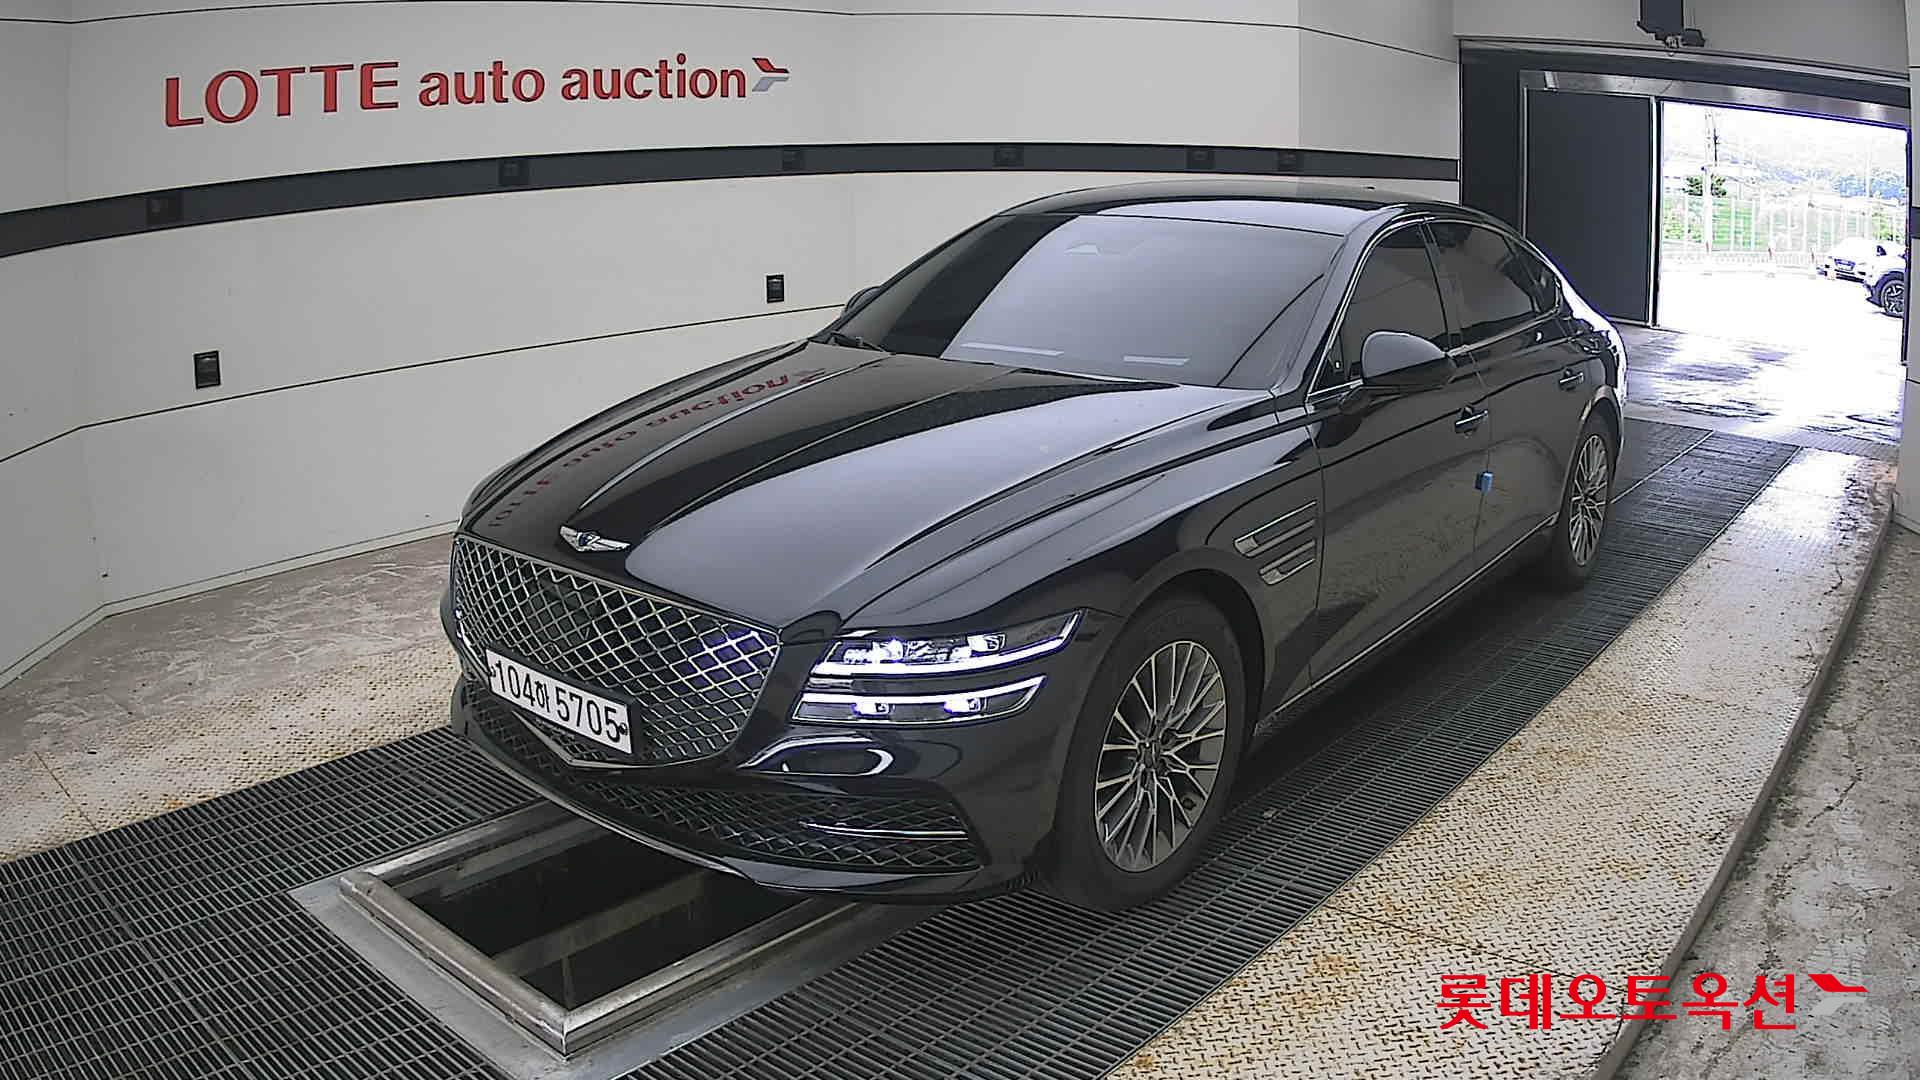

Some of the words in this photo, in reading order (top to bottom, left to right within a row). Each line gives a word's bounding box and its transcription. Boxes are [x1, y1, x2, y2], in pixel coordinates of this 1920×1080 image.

[165, 61, 399, 127] LOTTE
[418, 60, 546, 107] auto
[561, 53, 747, 100] auction
[556, 686, 621, 743] 5705
